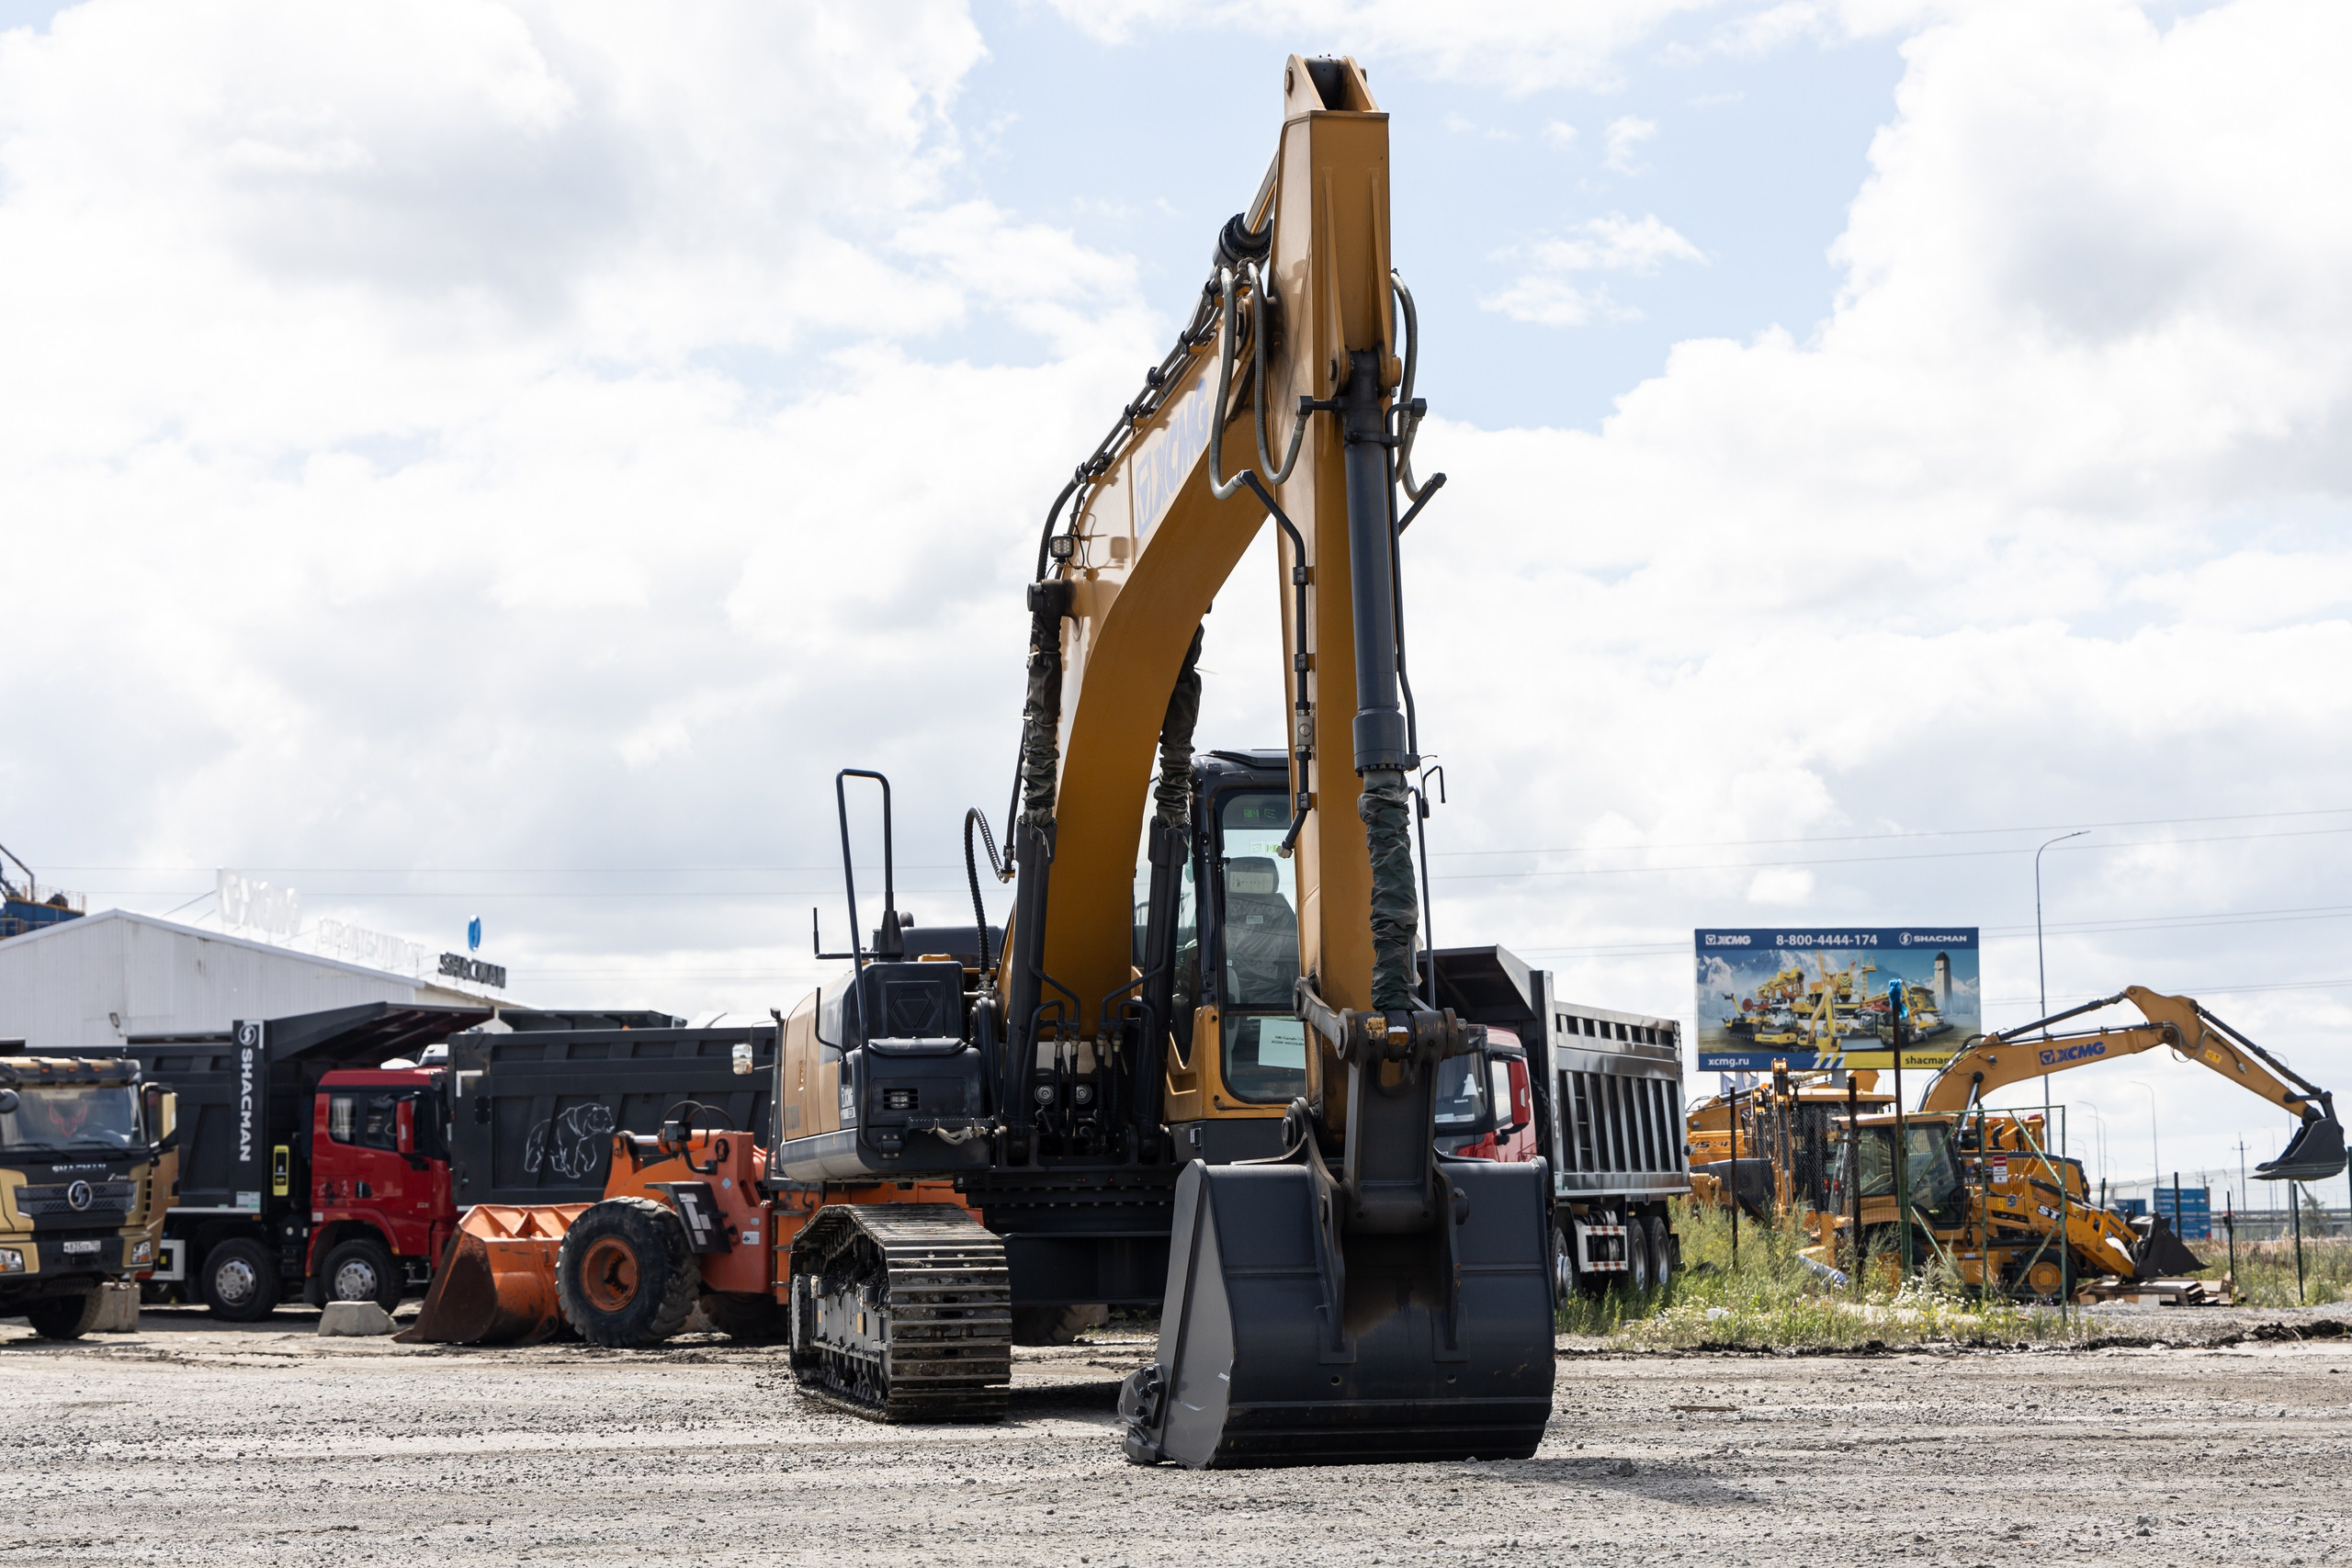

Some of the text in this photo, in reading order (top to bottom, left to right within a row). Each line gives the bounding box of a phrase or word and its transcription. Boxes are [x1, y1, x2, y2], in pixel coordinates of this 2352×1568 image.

[1153, 378, 1209, 513] XCMG
[1715, 935, 1751, 945] XCMG
[1776, 934, 1878, 946] 8-800-4444-174
[438, 952, 506, 989] SHACMAN
[1708, 1057, 1749, 1067] xcmg.ru
[2056, 1041, 2106, 1063] XCMG
[239, 1048, 254, 1162] SHACMAN
